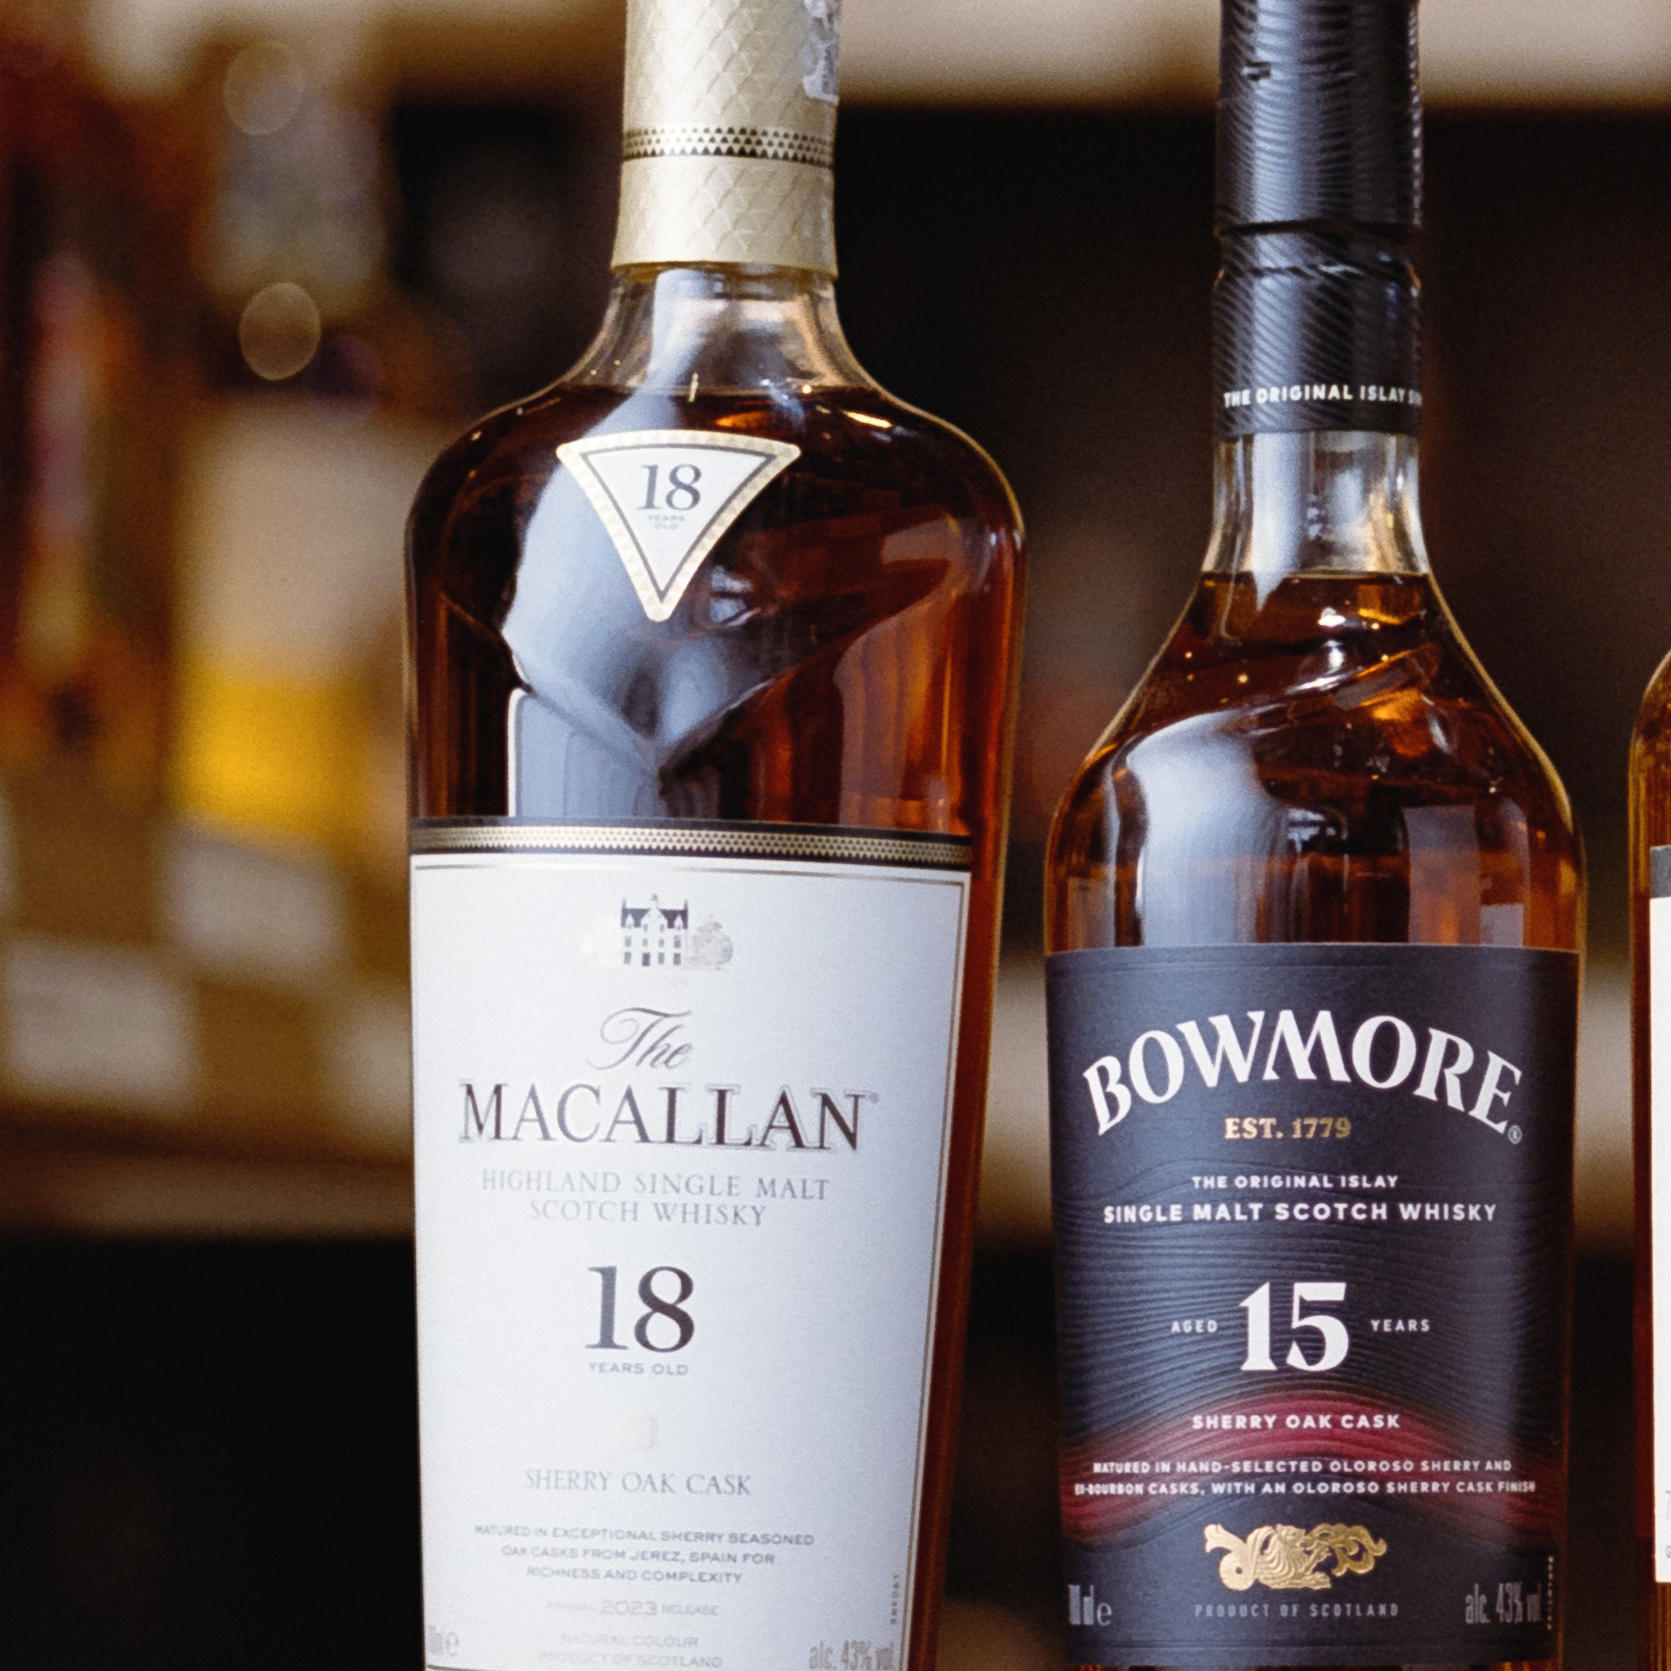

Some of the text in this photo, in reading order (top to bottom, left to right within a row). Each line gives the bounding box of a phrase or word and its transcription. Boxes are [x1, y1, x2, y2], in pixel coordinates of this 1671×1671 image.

[1223, 384, 1404, 408] THE ORIGINAL ISLAY
[637, 464, 702, 511] 18
[587, 1007, 692, 1070] The
[1082, 1009, 1522, 1136] BOWMORE
[459, 1079, 863, 1151] MACALLAN
[1225, 1117, 1352, 1139] EST. 1779
[482, 1169, 830, 1201] HIGHLAND SINGLE MALT
[1192, 1175, 1399, 1189] THE ORIGINAL ISLAY
[530, 1199, 766, 1227] SCOTCH WHISKY
[1104, 1202, 1496, 1223] SINGLE MALT SCOTCH WHISKY
[585, 1266, 696, 1353] 18
[1171, 1281, 1431, 1371] AGED 15 YEARS
[588, 1362, 688, 1376] YEARS OLD
[1192, 1414, 1400, 1429] SHERRY OAK CASK
[1154, 1461, 1171, 1473] IN
[1176, 1460, 1323, 1473] HAND-SELECTED
[1329, 1460, 1414, 1472] OLOROSO
[1420, 1460, 1481, 1472] SHERRY
[1484, 1459, 1512, 1472] AND
[524, 1469, 752, 1496] SHERRY OAK CASK
[1148, 1483, 1206, 1496] CASKS,
[1211, 1482, 1253, 1494] WITH
[1260, 1482, 1286, 1494] AN
[1292, 1482, 1380, 1494] OLOROSO
[1386, 1482, 1451, 1494] SHERRY
[1456, 1481, 1494, 1493] CASK
[552, 1527, 814, 1545] EXCEPTIONAL SHERRY SEASONED
[527, 1566, 741, 1584] RICHNESS AND COMPLEXITY
